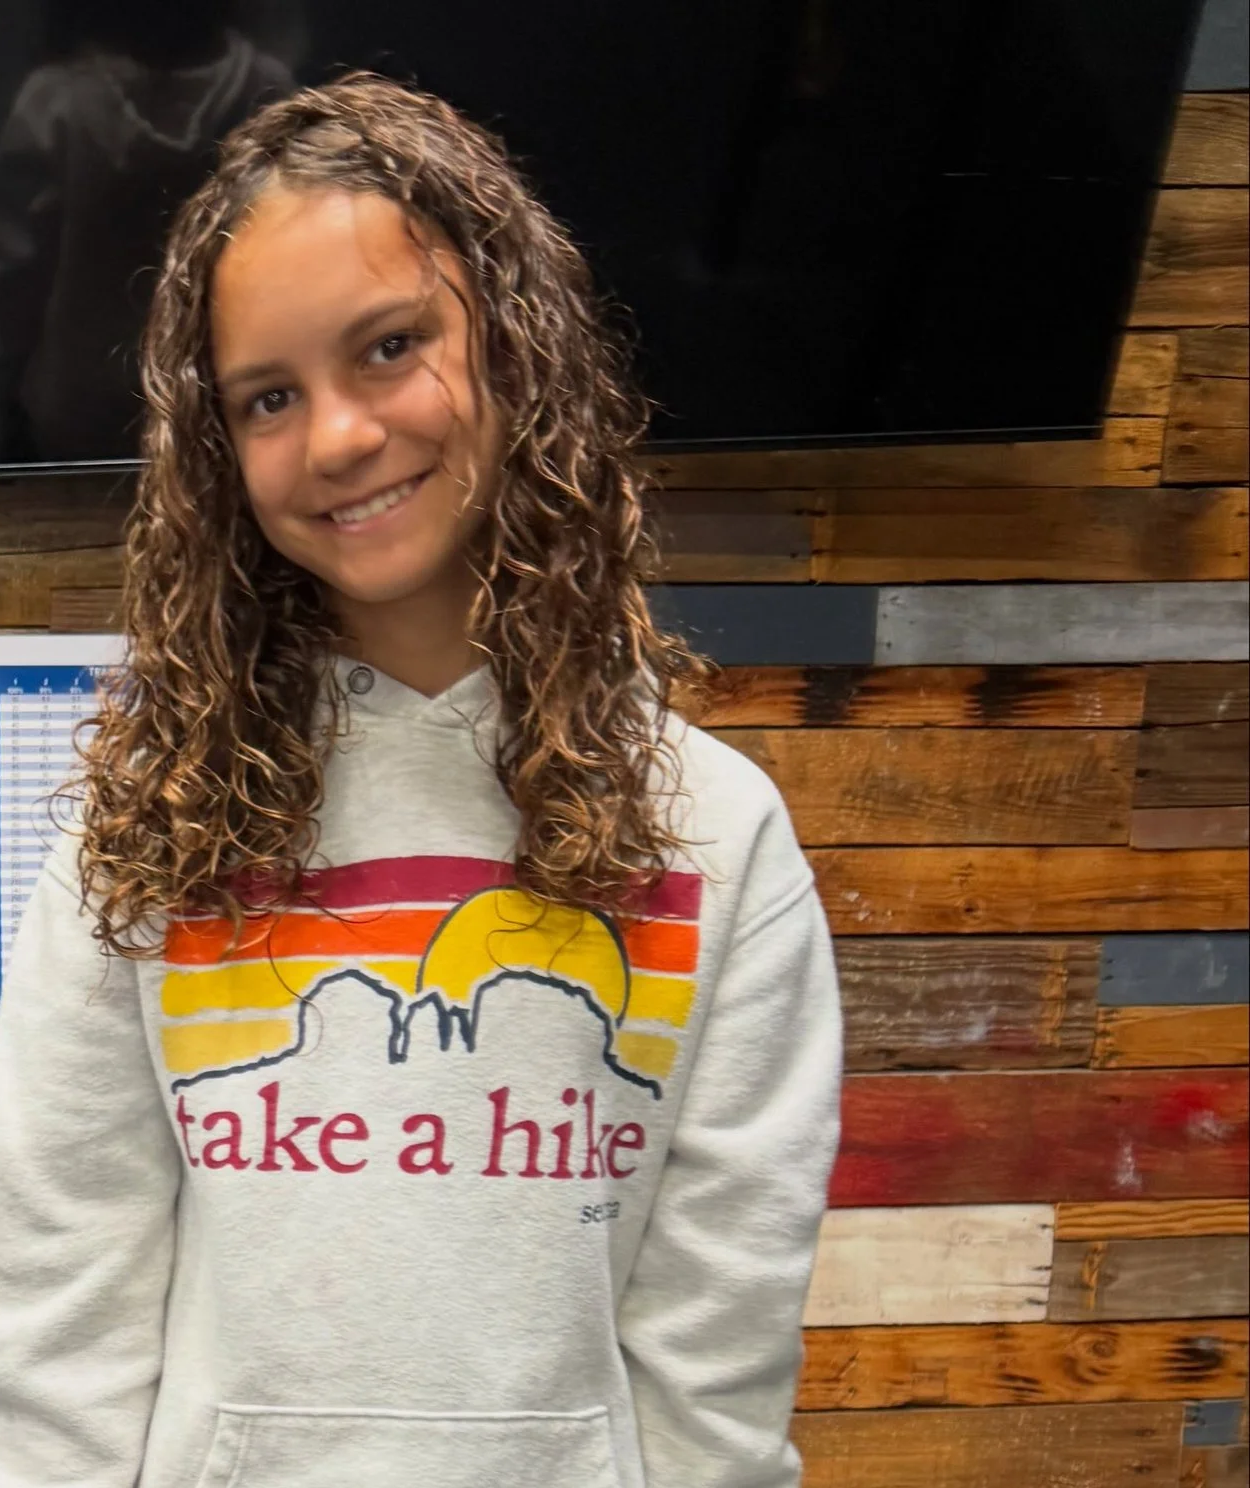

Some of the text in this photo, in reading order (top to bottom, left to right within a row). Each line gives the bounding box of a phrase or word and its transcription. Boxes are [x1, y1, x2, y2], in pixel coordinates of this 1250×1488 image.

[176, 1081, 646, 1180] take a hike
